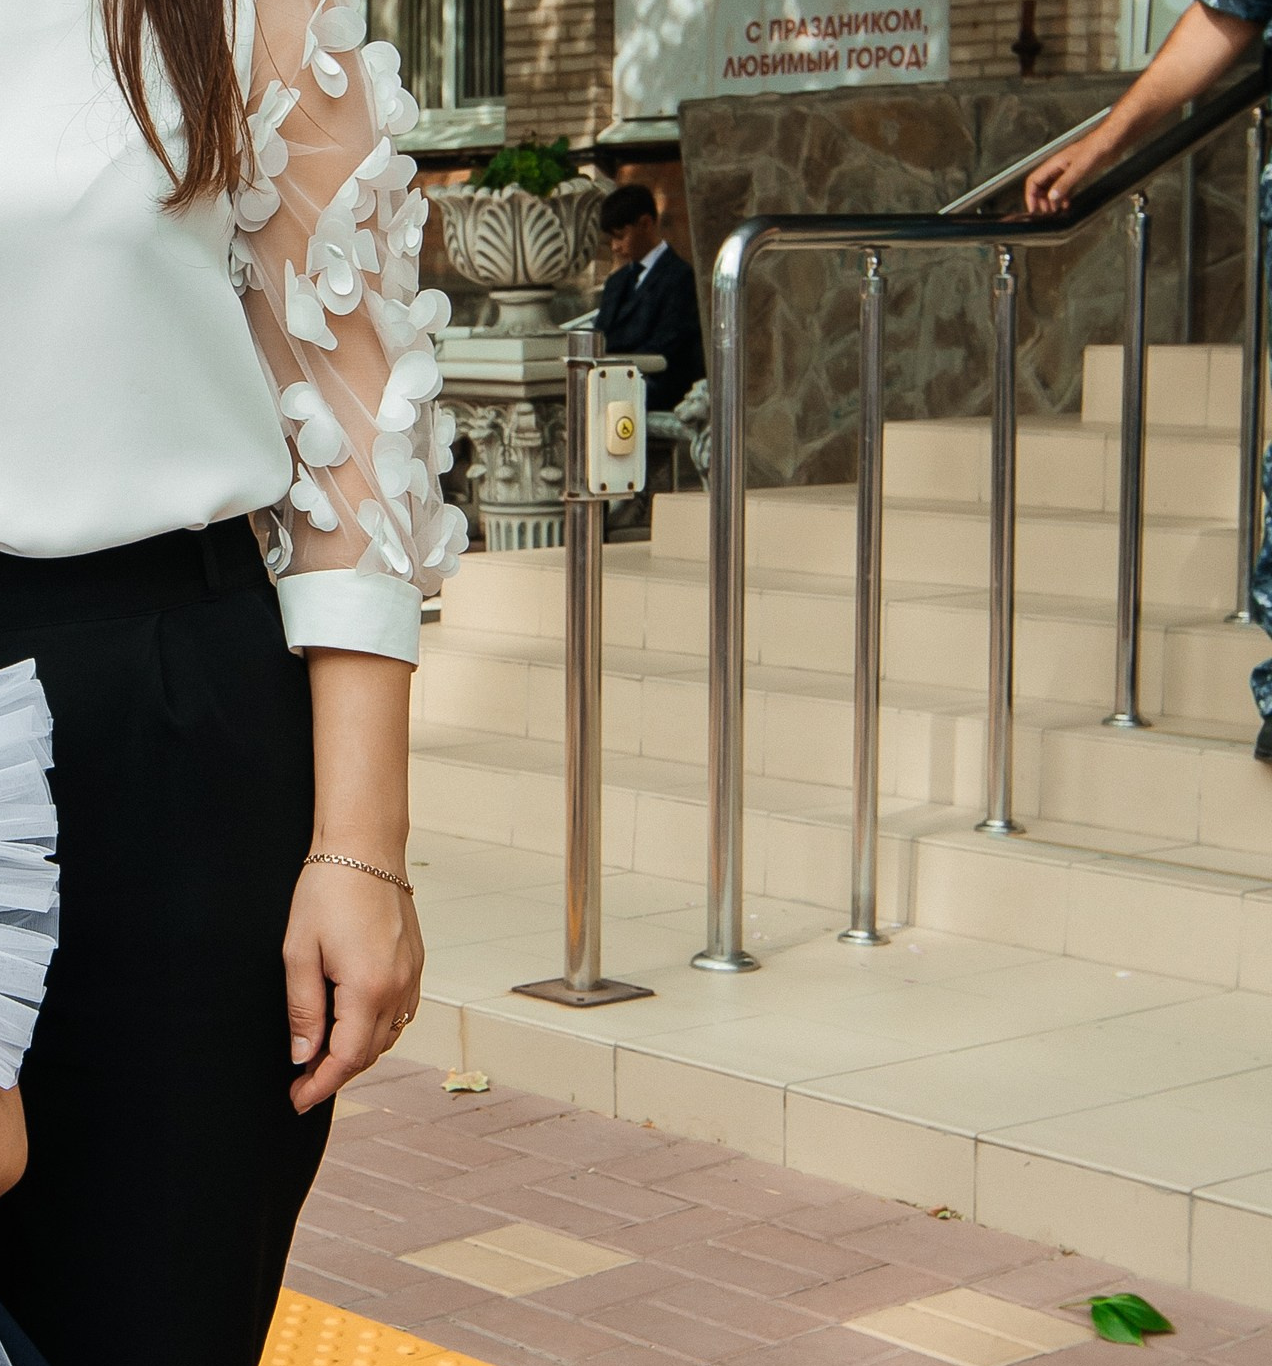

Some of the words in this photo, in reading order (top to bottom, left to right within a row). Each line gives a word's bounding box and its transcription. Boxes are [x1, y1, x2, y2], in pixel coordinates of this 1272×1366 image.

[746, 21, 762, 43] С
[768, 9, 928, 42] ПРАЗДНИКОМ,
[723, 46, 840, 79] ЛЮБИМЫЙ
[847, 43, 928, 71] ГОРОД!
